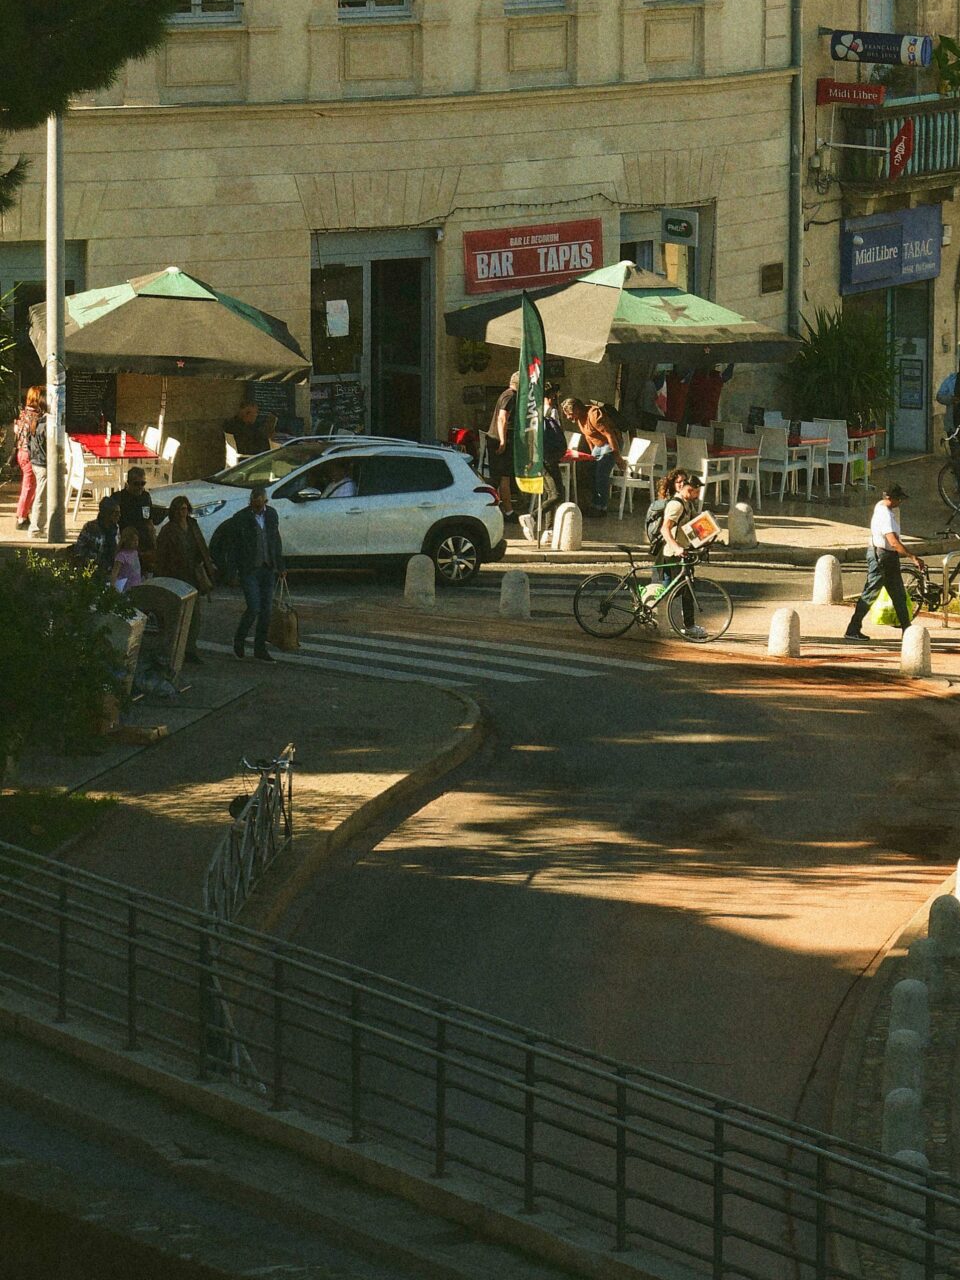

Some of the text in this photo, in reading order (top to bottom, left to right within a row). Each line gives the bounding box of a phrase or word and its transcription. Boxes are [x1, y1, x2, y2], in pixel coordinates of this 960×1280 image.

[829, 88, 878, 100] Midi Libre
[894, 136, 908, 166] TABAC
[509, 236, 523, 247] BAR
[523, 235, 531, 245] LE
[902, 238, 934, 260] TABAC
[476, 243, 593, 279] BAR TAPAS
